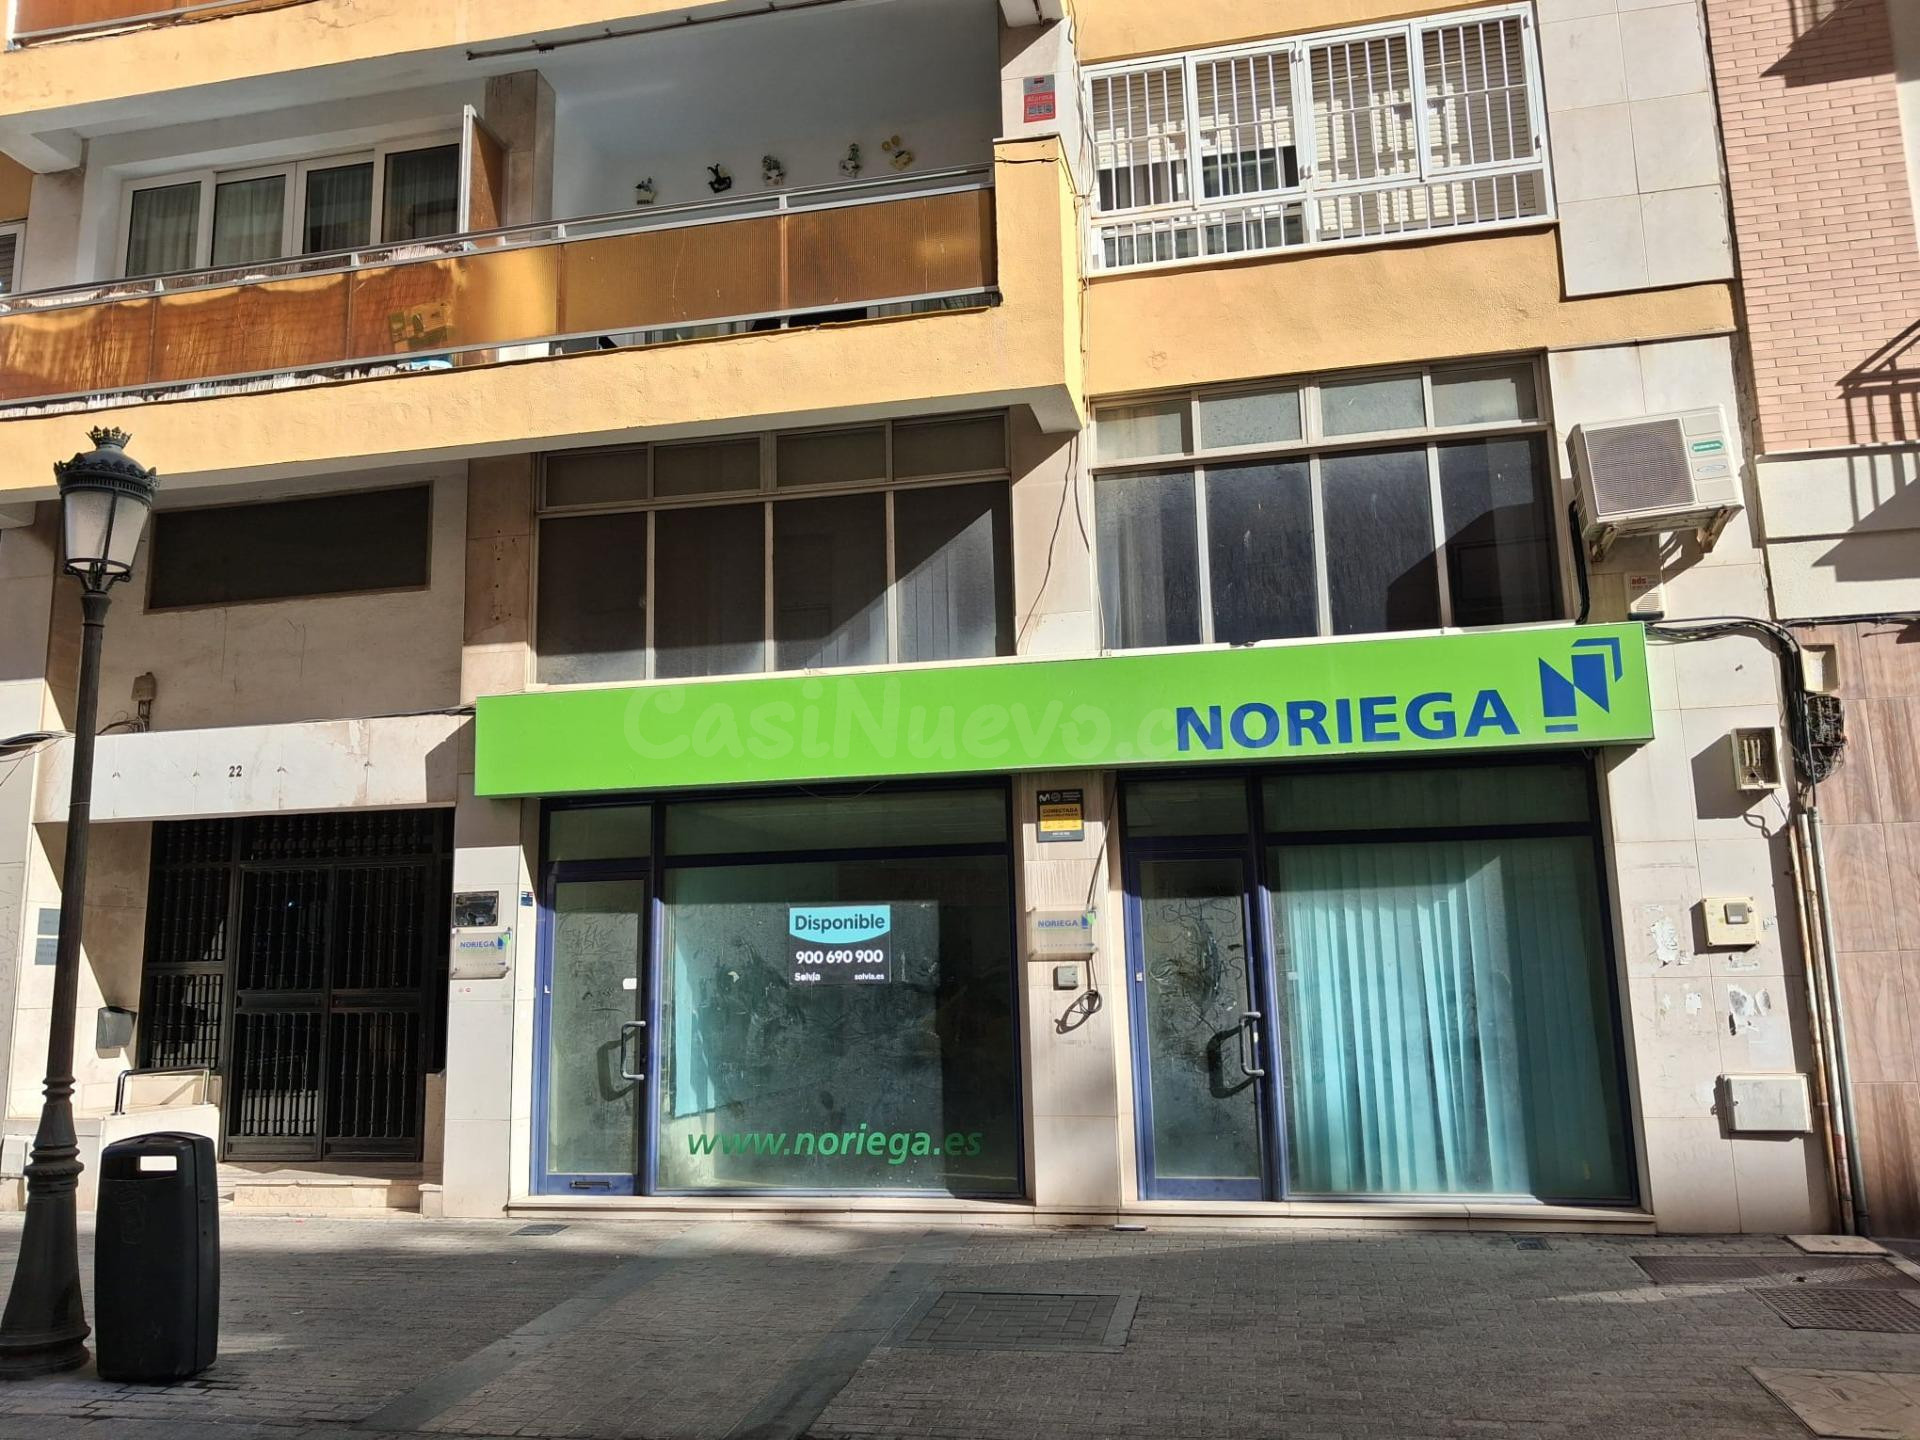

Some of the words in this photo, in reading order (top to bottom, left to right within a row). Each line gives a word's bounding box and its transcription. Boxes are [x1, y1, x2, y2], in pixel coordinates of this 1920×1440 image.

[1175, 689, 1521, 751] NORIEGA
[229, 765, 243, 778] 22
[795, 913, 885, 934] Disponible
[1038, 919, 1079, 928] NORIEGA
[460, 940, 496, 948] NORIEGA
[795, 950, 824, 964] 900
[826, 950, 853, 964] 690
[855, 949, 884, 963] 900
[854, 972, 885, 981] solvia.es
[687, 1123, 984, 1165] www.noriega.es
